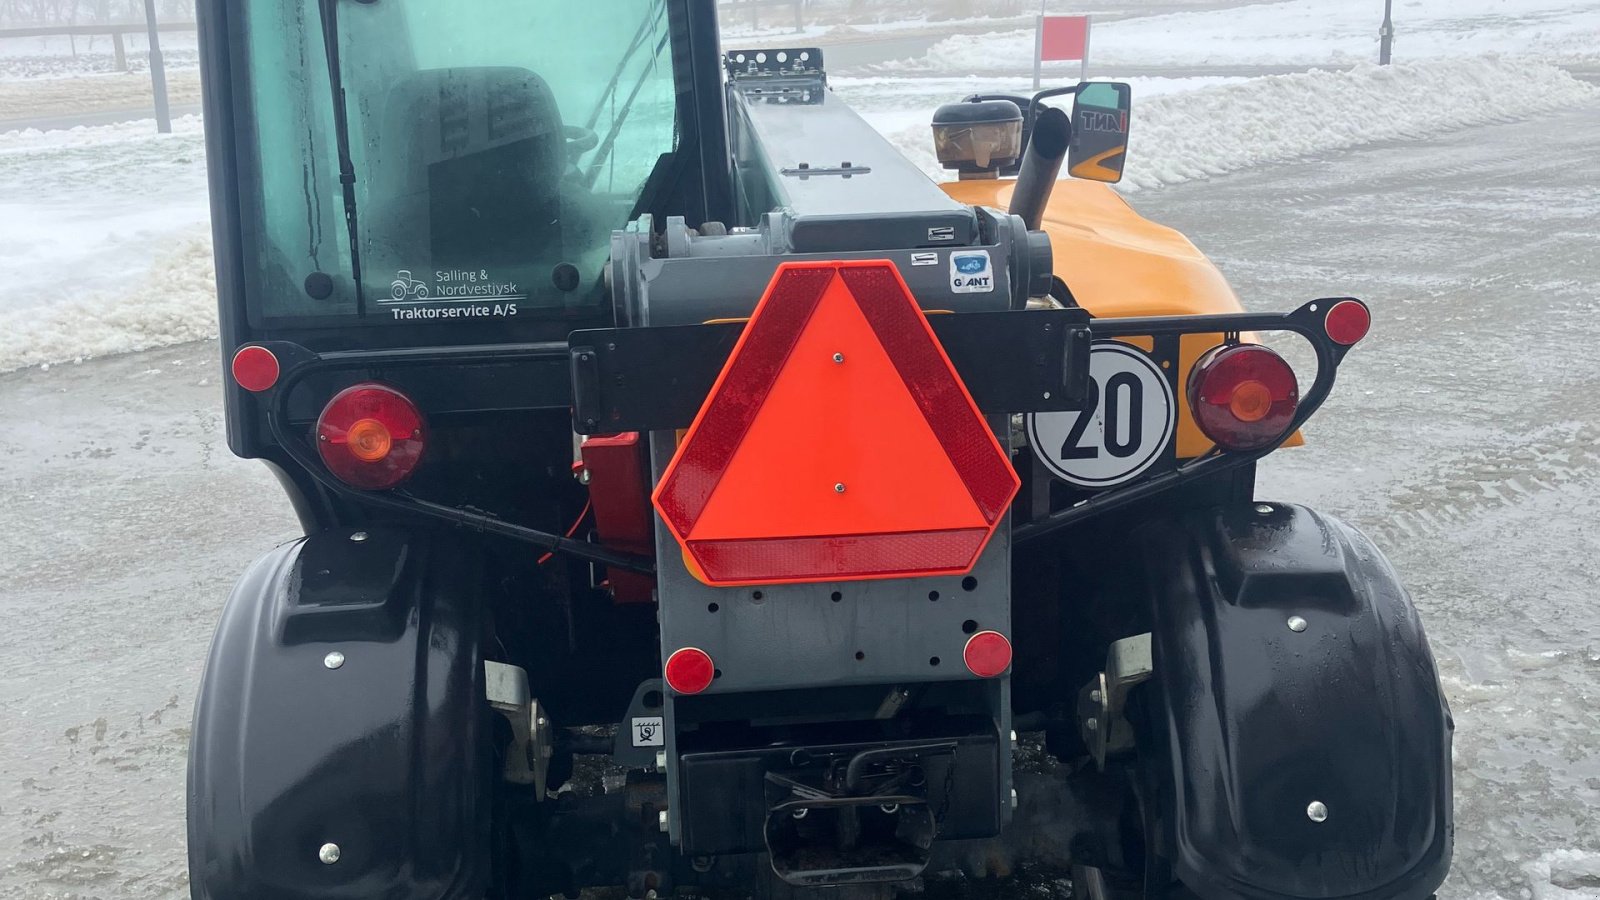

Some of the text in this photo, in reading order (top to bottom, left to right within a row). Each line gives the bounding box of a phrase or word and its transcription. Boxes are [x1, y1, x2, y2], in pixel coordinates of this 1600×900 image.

[436, 269, 488, 282] Salling &
[954, 277, 989, 287] GANT
[437, 282, 517, 295] Nordvestjysk
[392, 304, 516, 320] Traktorservice A/S
[1061, 371, 1142, 460] 20
